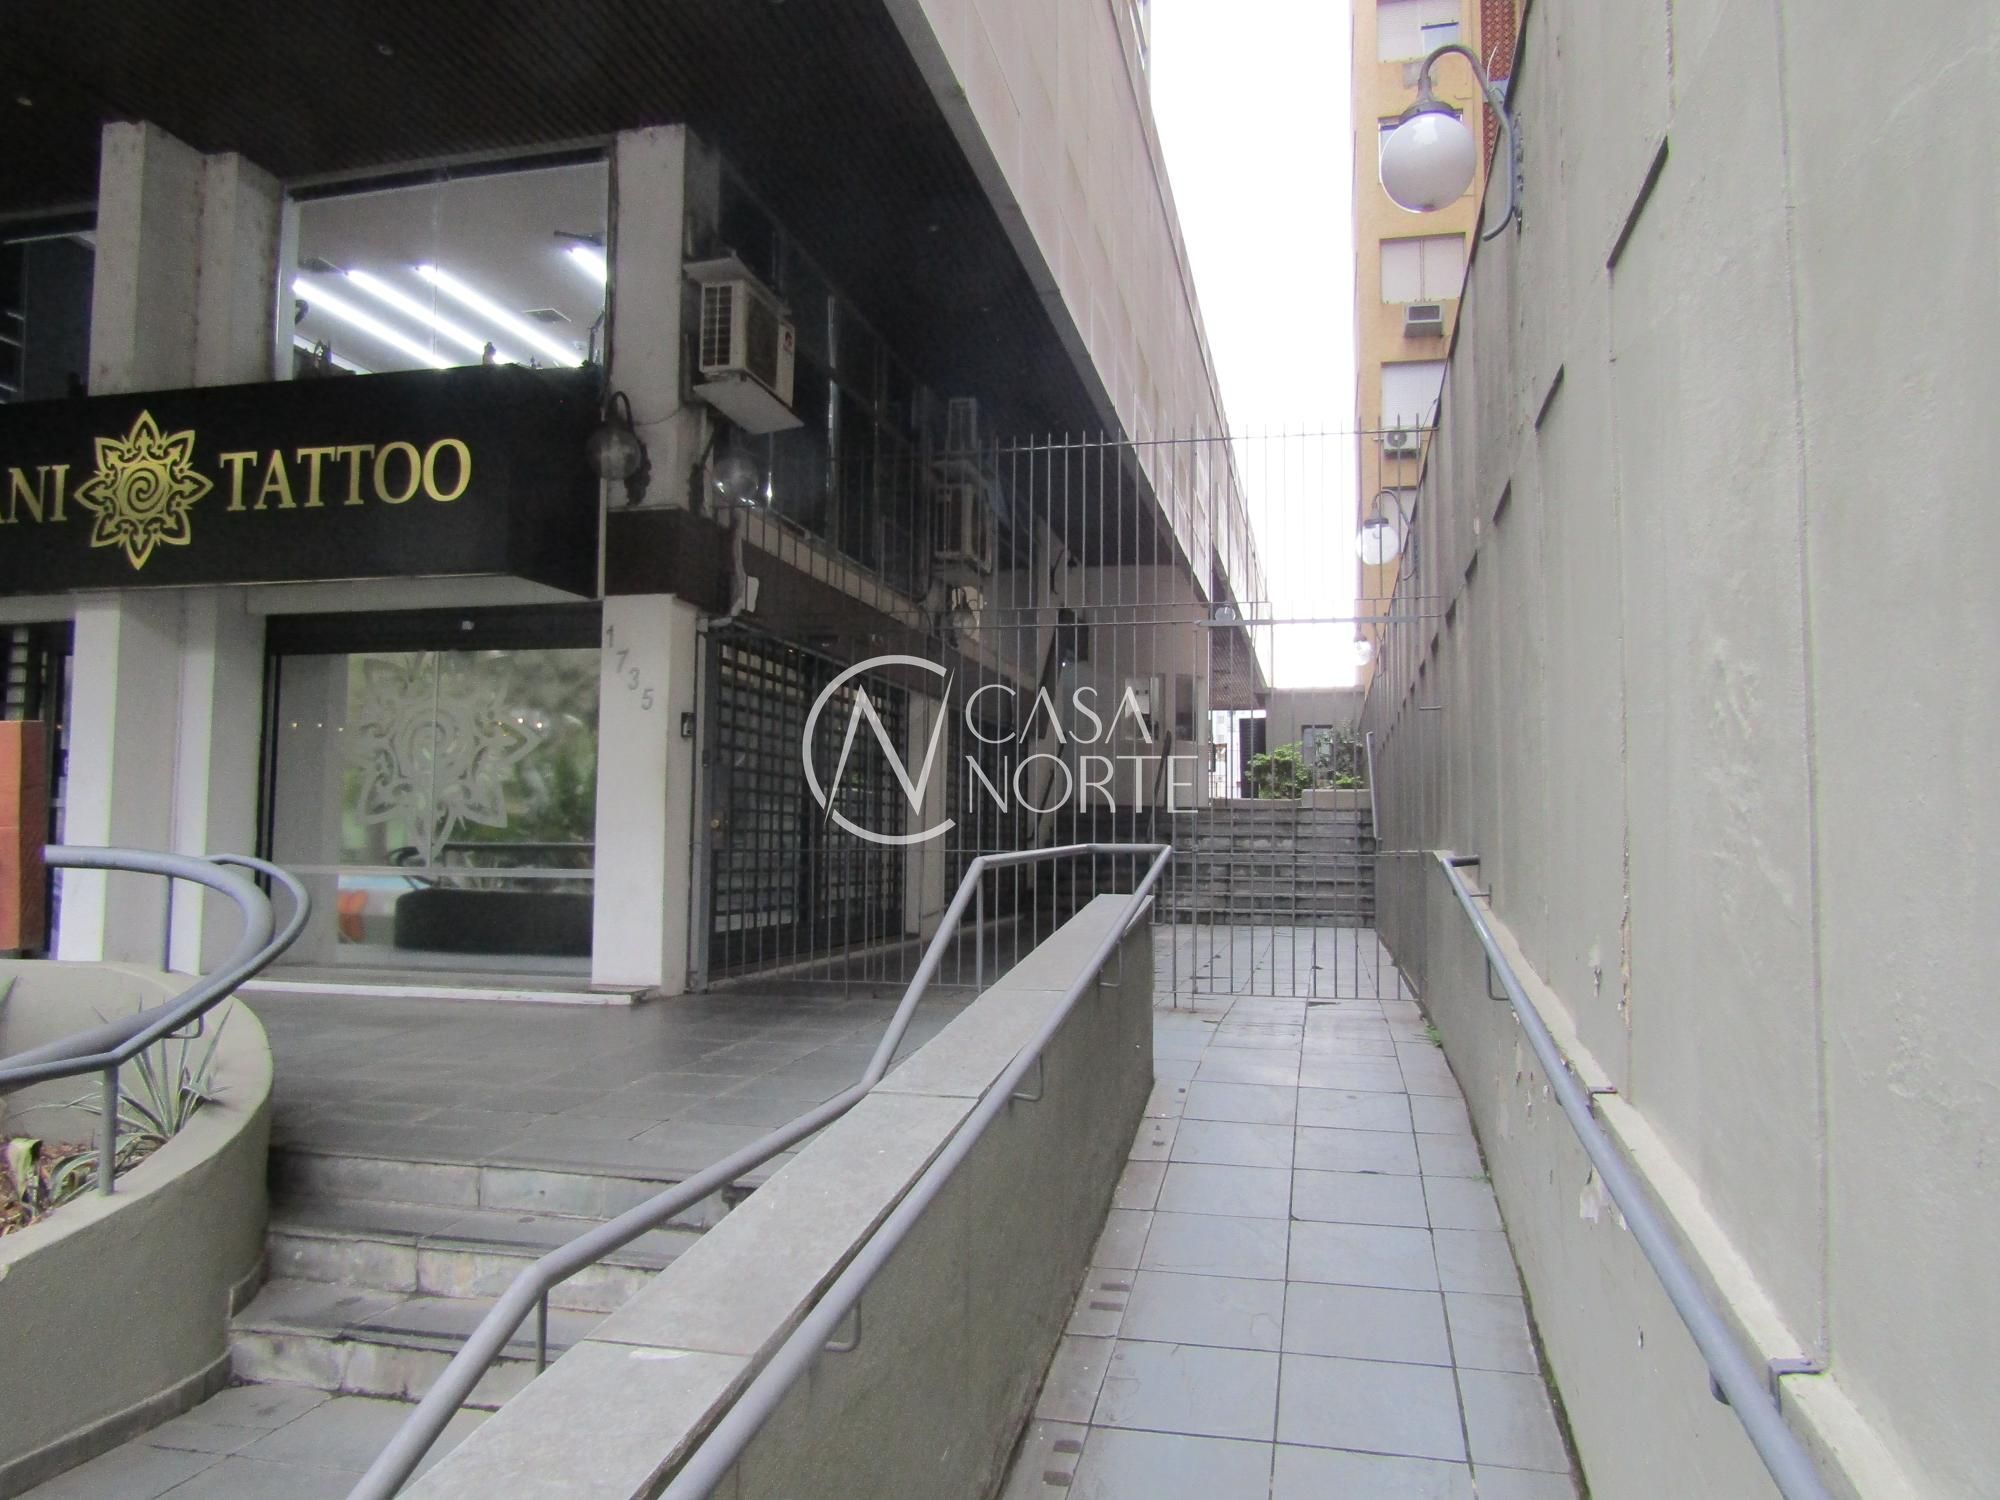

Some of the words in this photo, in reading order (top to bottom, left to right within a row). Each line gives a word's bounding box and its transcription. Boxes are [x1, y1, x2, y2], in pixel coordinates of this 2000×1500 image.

[0, 464, 70, 523] NI
[219, 438, 472, 511] TATTOO
[606, 624, 655, 710] 1735
